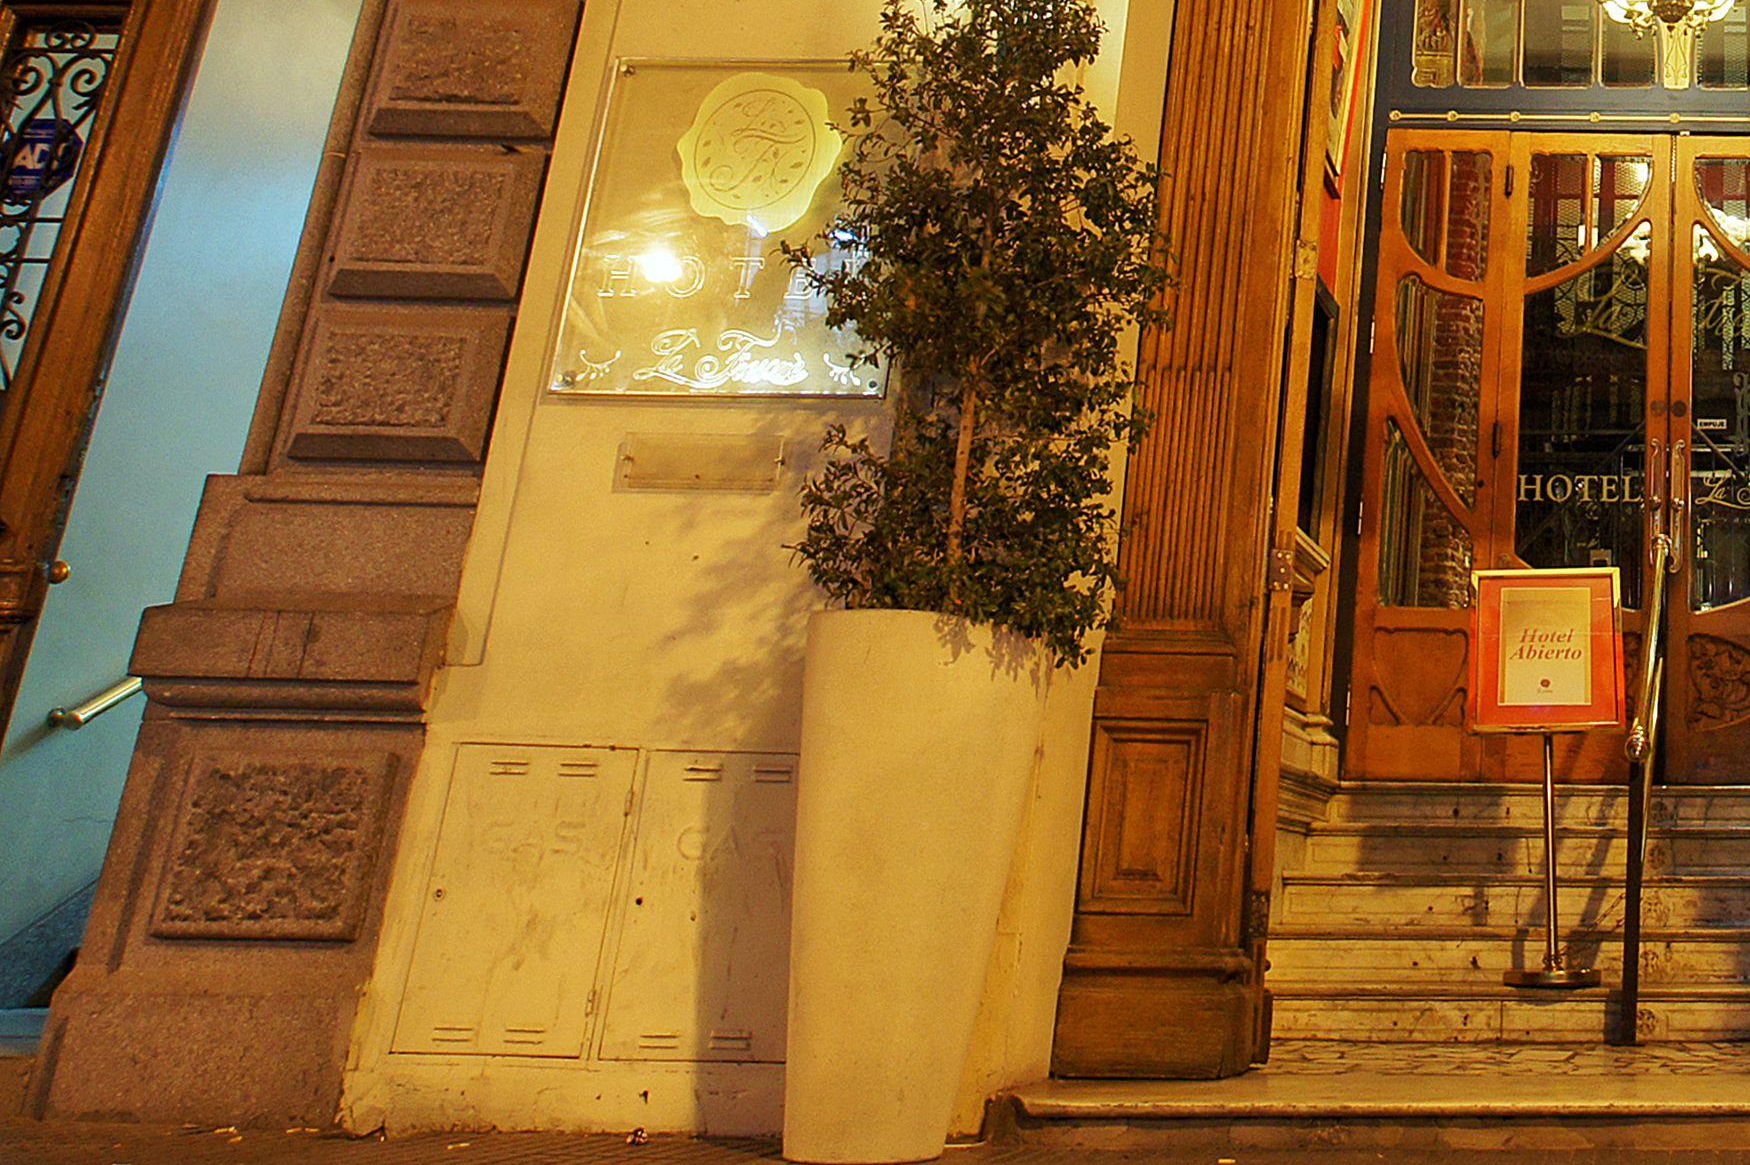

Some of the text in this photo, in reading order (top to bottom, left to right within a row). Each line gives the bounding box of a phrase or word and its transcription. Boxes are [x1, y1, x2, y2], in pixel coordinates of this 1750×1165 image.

[1518, 474, 1644, 503] HOTEL
[1519, 627, 1575, 643] Hotel
[1509, 643, 1583, 661] Abierto
